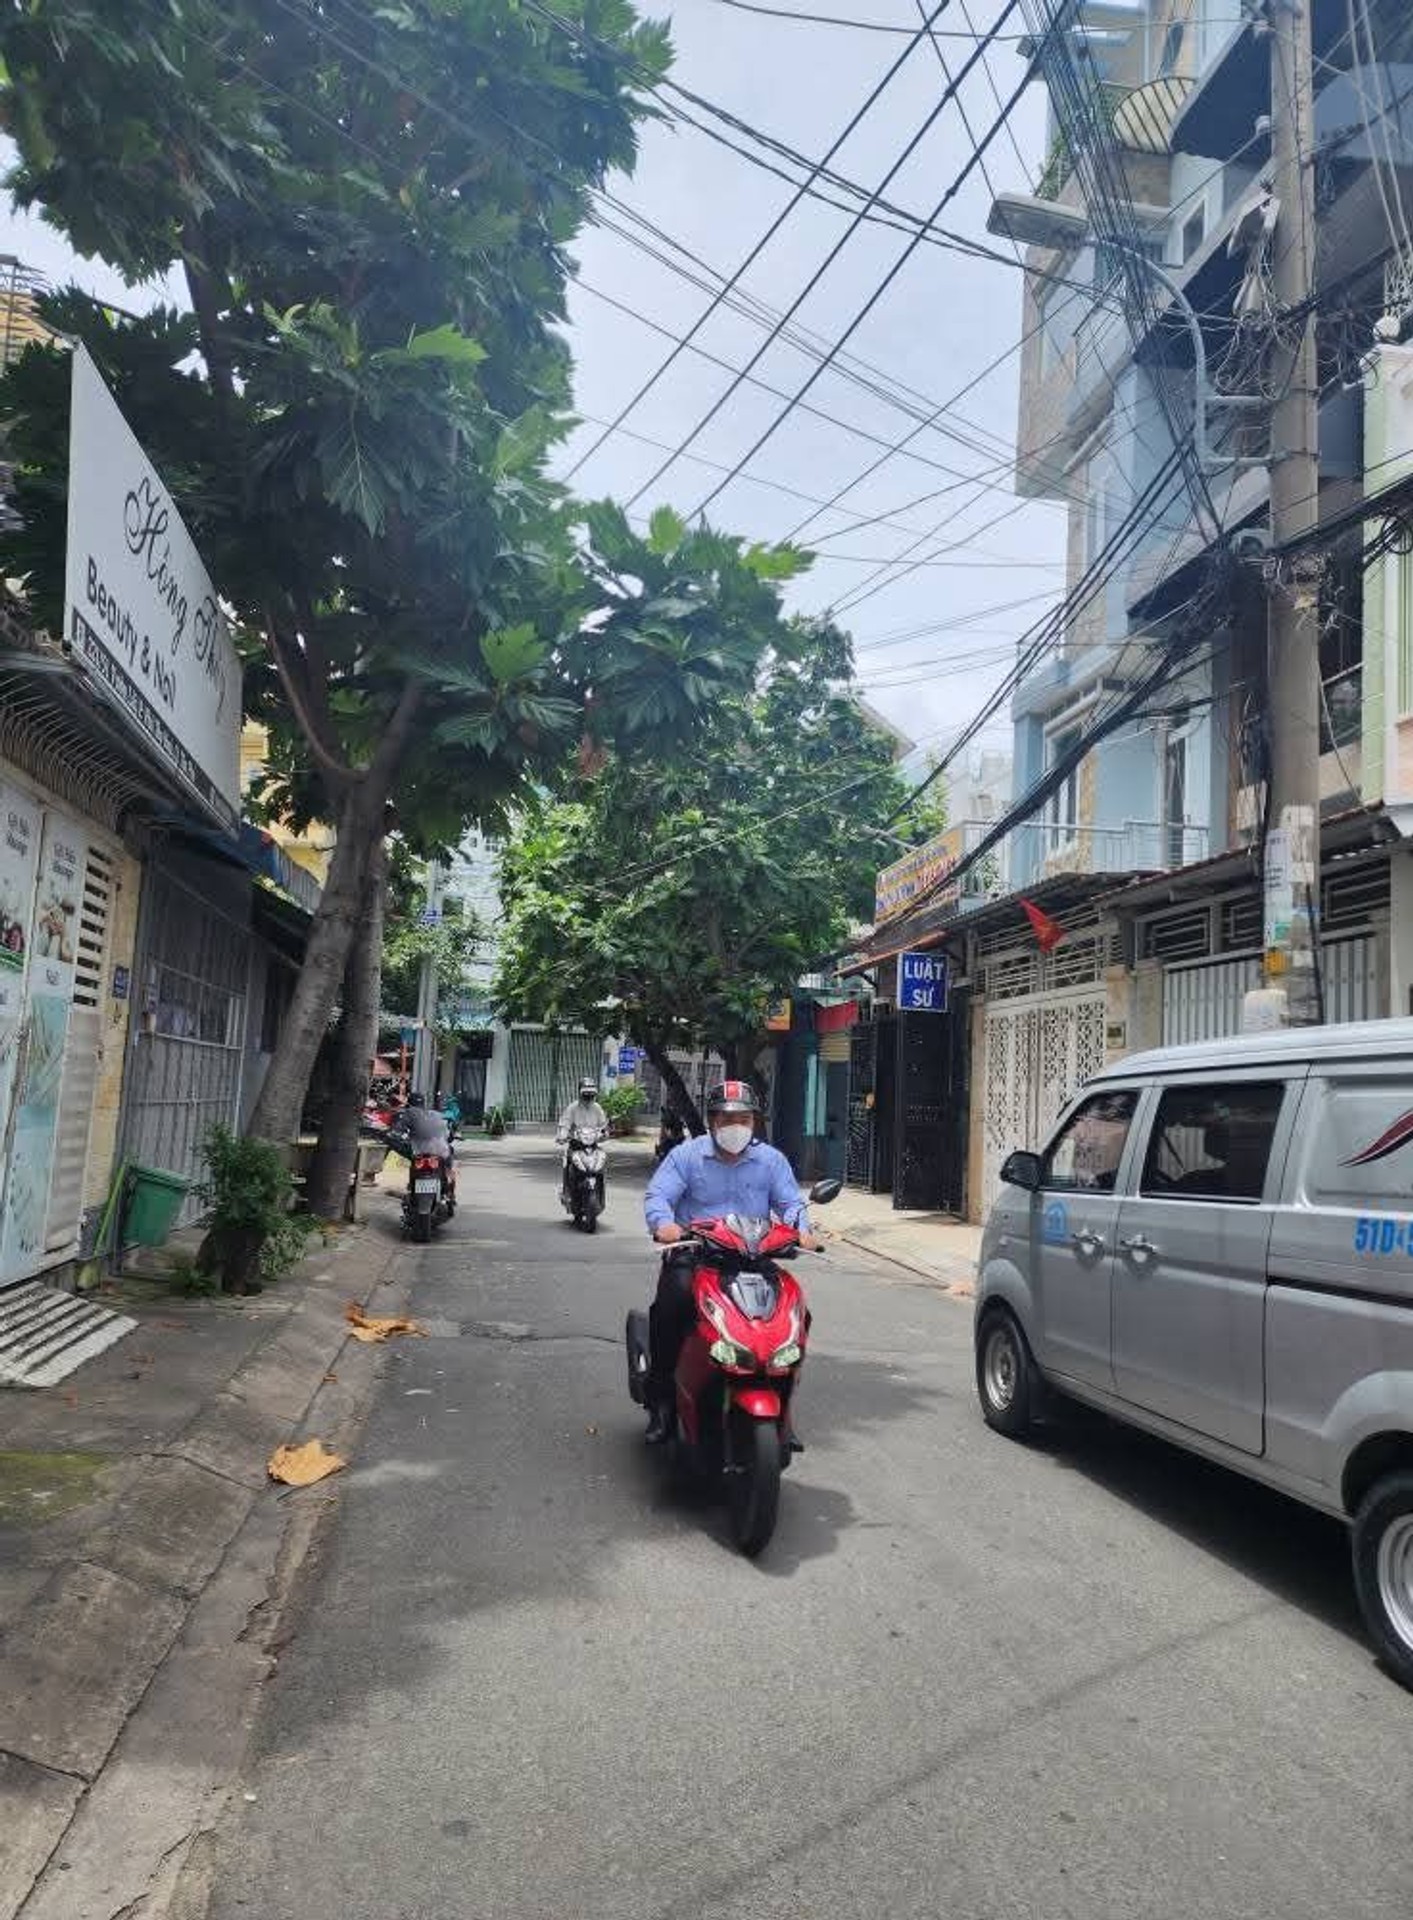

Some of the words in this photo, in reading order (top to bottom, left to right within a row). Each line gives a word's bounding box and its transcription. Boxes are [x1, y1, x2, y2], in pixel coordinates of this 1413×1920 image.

[87, 554, 137, 667] Beauty
[141, 635, 150, 675] &
[904, 958, 944, 983] LUẬT
[912, 986, 935, 1007] SƯ
